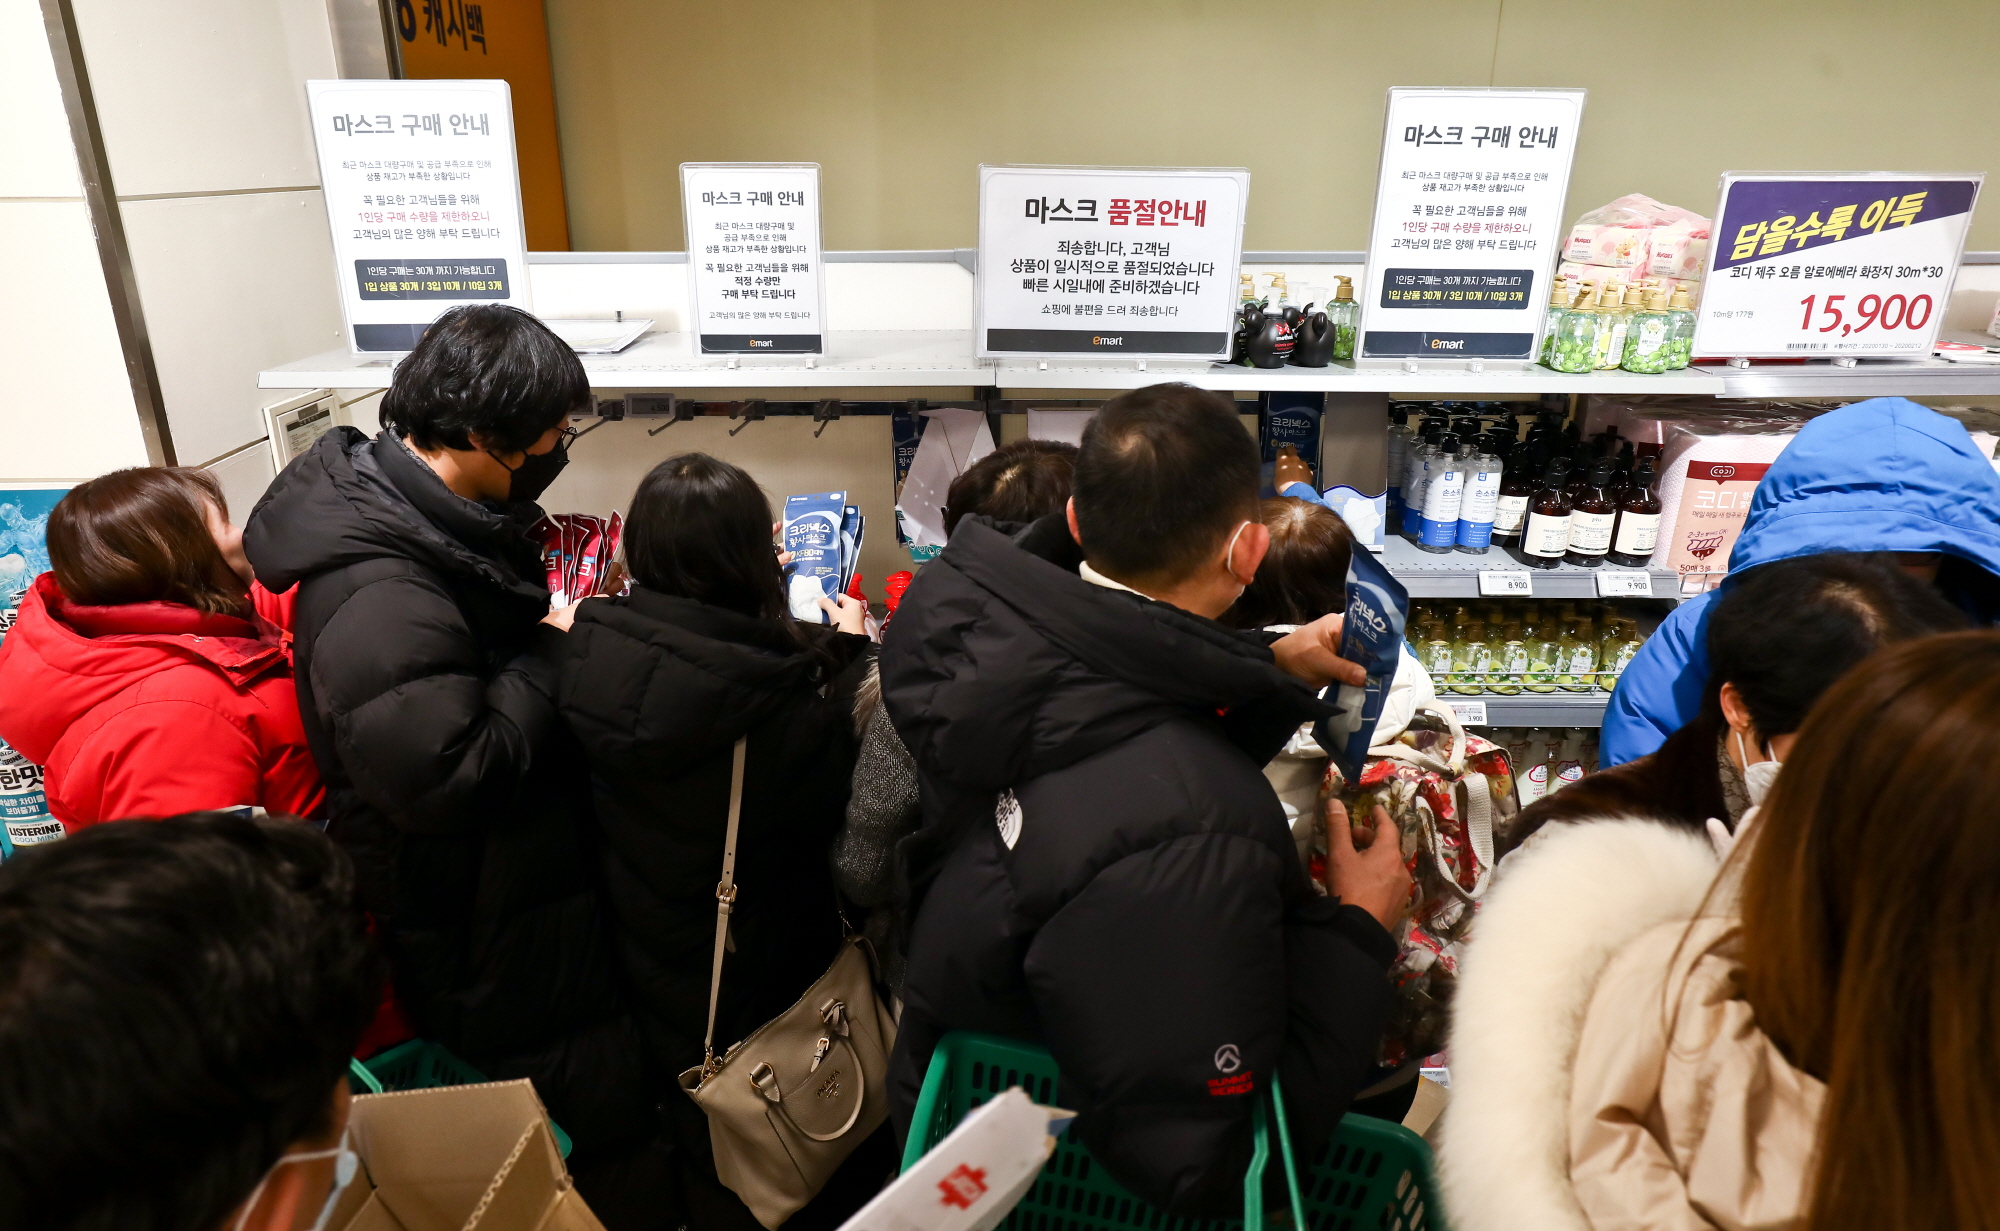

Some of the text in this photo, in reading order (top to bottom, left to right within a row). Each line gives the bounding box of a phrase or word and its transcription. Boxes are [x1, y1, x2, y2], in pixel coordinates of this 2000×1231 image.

[333, 113, 489, 136] 마스크 구매 안내
[1405, 125, 1558, 148] 마스크 구매 안내
[1402, 171, 1416, 179] 최근
[1444, 172, 1473, 180] 대량구매
[1476, 172, 1482, 180] 및
[1485, 172, 1499, 180] 공급
[1534, 173, 1548, 181] 인해
[1423, 183, 1436, 191] 상품
[1464, 184, 1485, 192] 부족한
[1488, 184, 1524, 192] 상황입니다
[364, 194, 479, 205] 꼭 필요한 고객님들을 위해
[703, 191, 803, 206] 마스크 구매 안내
[1026, 197, 1206, 227] 마스크 품절안내
[1412, 205, 1527, 217] 꼭 필요한 고객님들을 위해
[358, 211, 489, 223] 1인당 구매 수량을 제한하오니
[715, 222, 729, 230] 최근
[756, 222, 784, 230] 대량구매
[788, 222, 794, 230] 및
[1403, 222, 1531, 233] 1인당 구매 수량을 제한하오니
[1730, 191, 1928, 261] 담을수록 이득
[353, 228, 500, 239] 고객님의 많은 양해 부탁 드립니다
[724, 234, 738, 242] 공급
[706, 245, 720, 253] 상품
[747, 245, 768, 253] 부족한
[771, 245, 806, 253] 상황입니다
[1058, 240, 1169, 256] 죄송합니다, 고객님
[1391, 239, 1536, 250] 고객님의 많은 양해 부탁 드립니다
[706, 263, 808, 272] 꼭 필요한 고객님들을 위해
[1011, 259, 1214, 276] 상품이 일시적으로 품절되었습니다
[1730, 266, 1750, 279] 코디
[1755, 266, 1776, 279] 제주
[1779, 266, 1800, 279] 오름
[1804, 266, 1857, 279] 알로에베라
[1859, 266, 1893, 278] 화장지
[735, 276, 780, 286] 적정 수량만
[1396, 276, 1521, 285] 1인당 구매는 30개 까지 가능합니다
[1023, 278, 1200, 295] 빠른 시일내에 준비하겠습니다
[722, 290, 795, 299] 구매 부탁 드립니다
[1388, 290, 1523, 301] 1입 상품 30개 3입 10개 10입 3개
[1042, 304, 1178, 316] 쇼핑에 불편을 드려 죄송합니다
[1801, 294, 1932, 337] 15,900
[1094, 337, 1122, 345] emart
[1431, 339, 1464, 350] emart
[1272, 417, 1312, 428] 크리넥스
[1694, 490, 1737, 509] 코디
[789, 523, 832, 536] 크리넥스
[9, 823, 61, 837] LISTERINE
[37, 833, 59, 842] MINT
[815, 1070, 840, 1098] PRADA
[1207, 1071, 1253, 1088] SUMMIT
